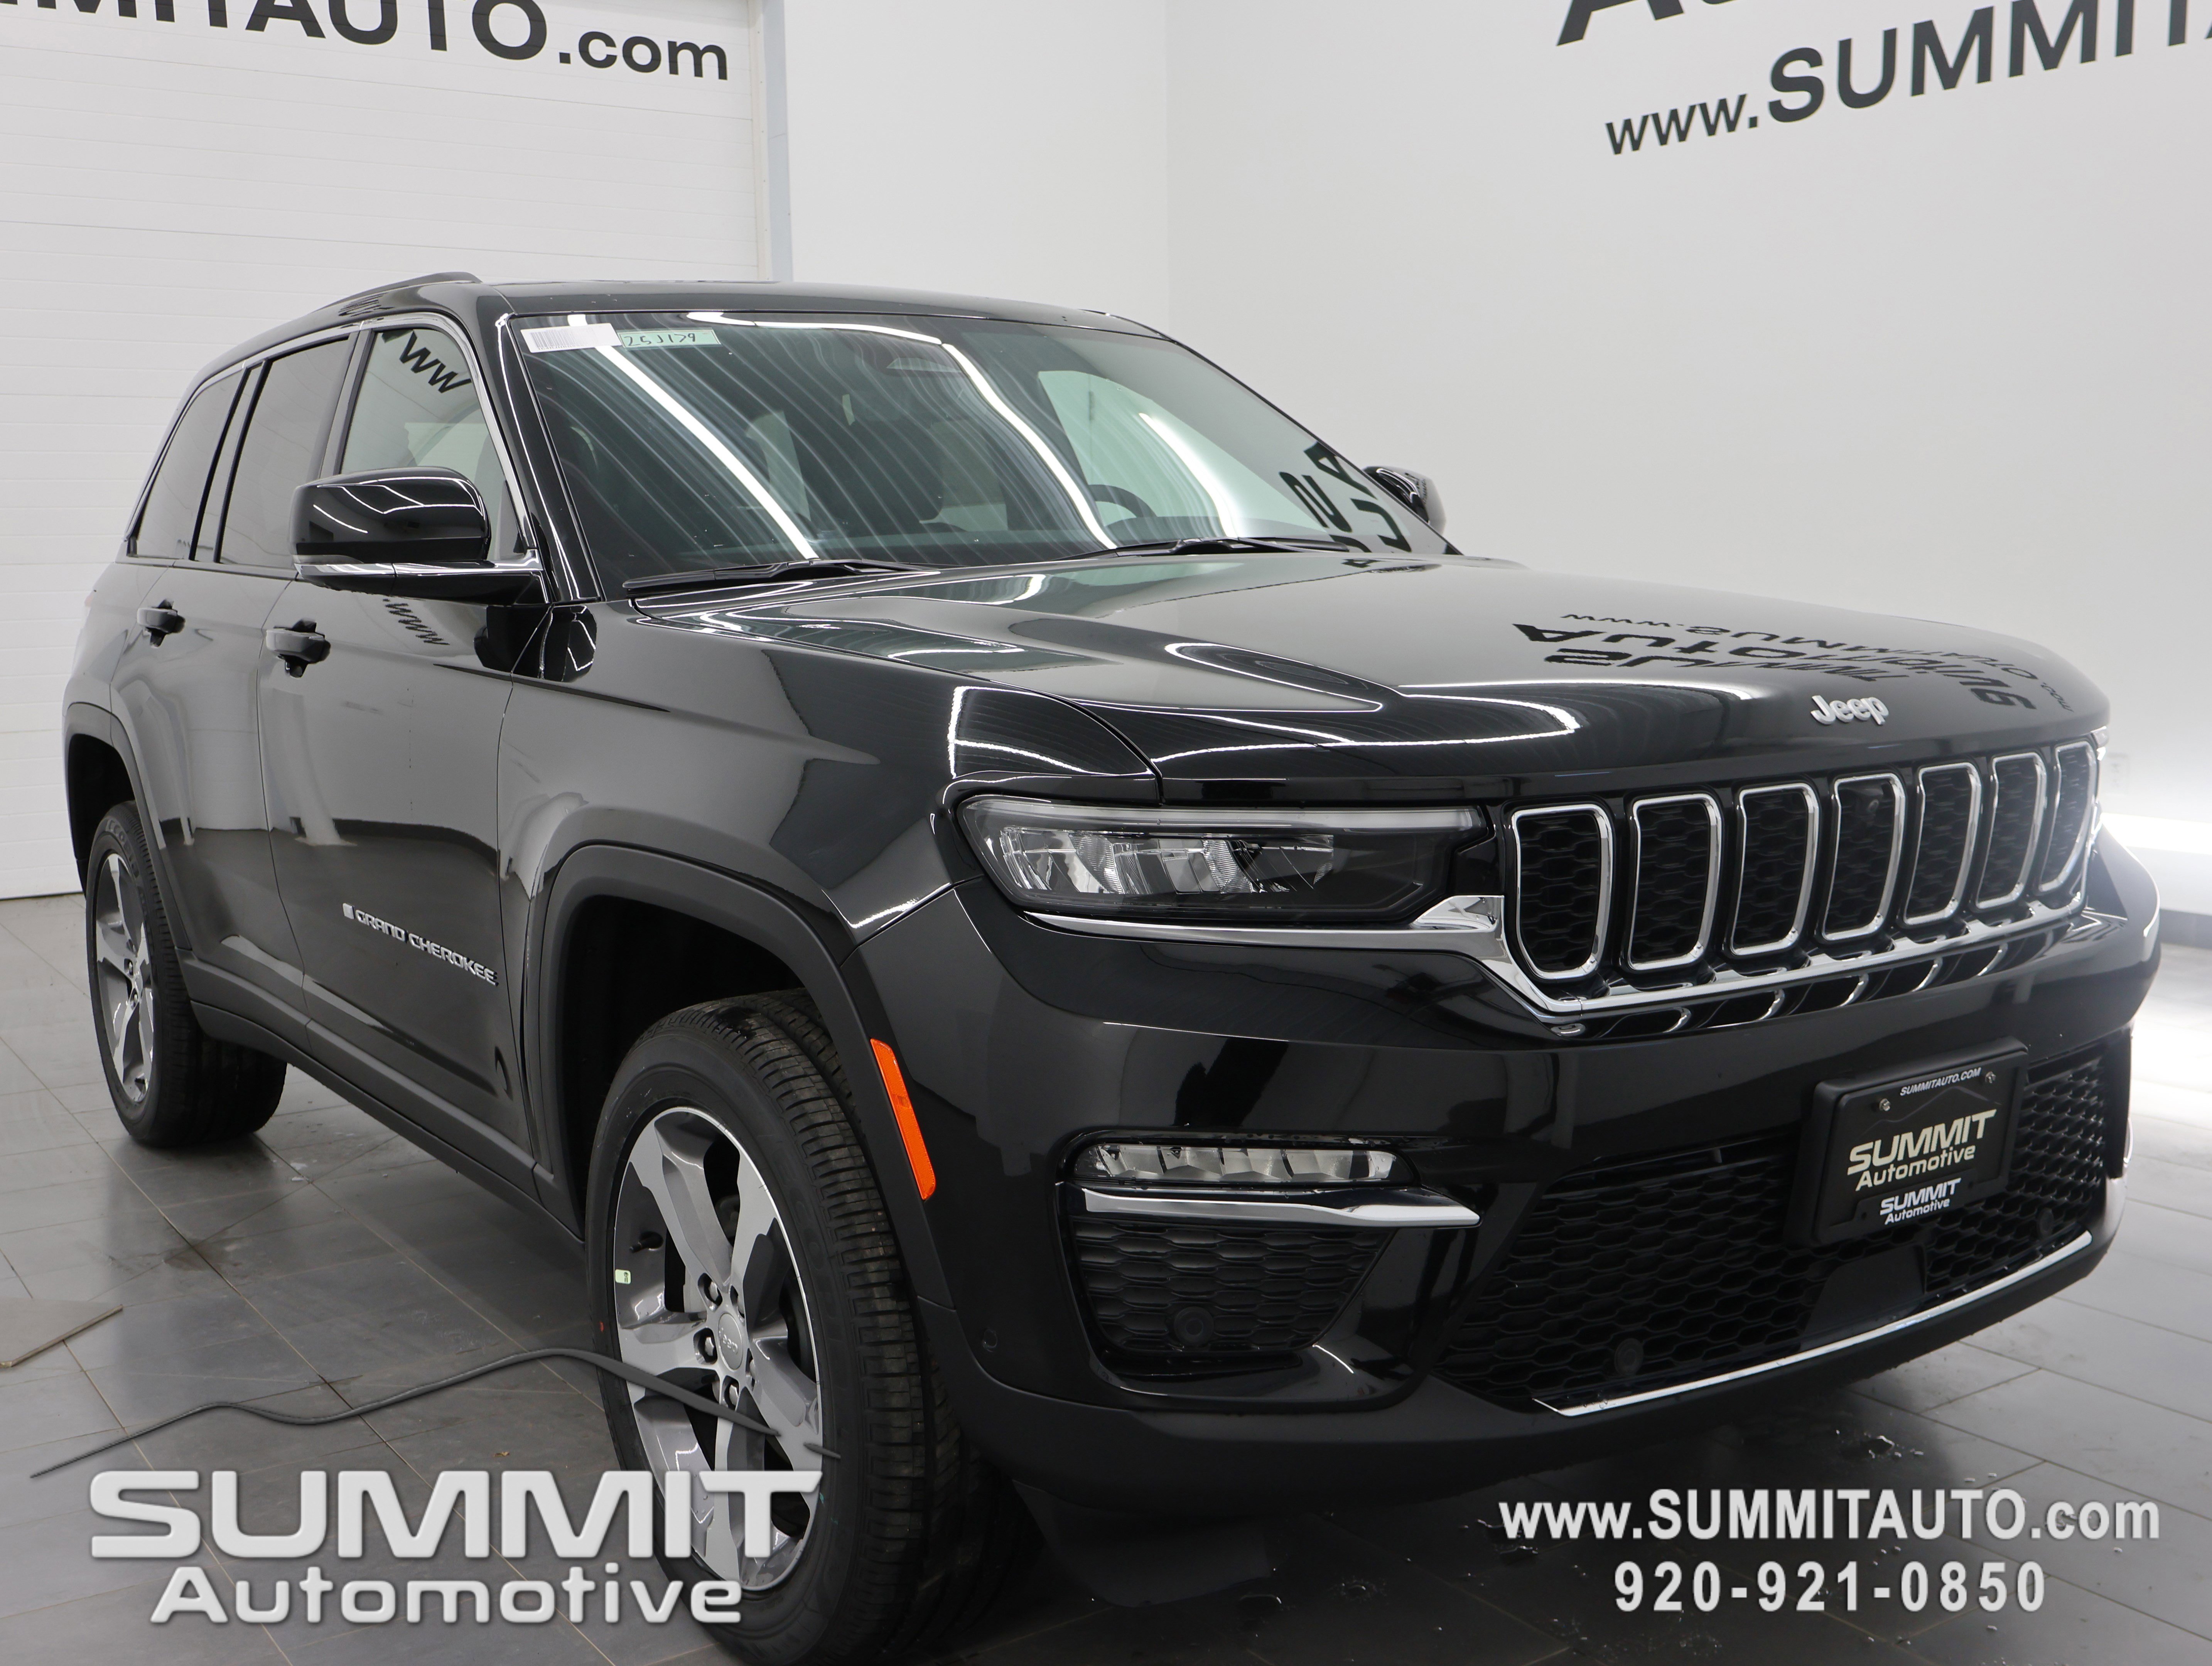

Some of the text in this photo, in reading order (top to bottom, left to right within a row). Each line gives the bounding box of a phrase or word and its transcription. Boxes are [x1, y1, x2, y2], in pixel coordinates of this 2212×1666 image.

[1810, 695, 1889, 725] Jeep
[355, 909, 499, 987] GRAND CHEROKEE
[1899, 1067, 1982, 1096] SUMMITAUTO.COM
[1847, 1108, 1998, 1175] SUMMIT
[1855, 1144, 1976, 1192] Automotive
[1879, 1177, 1962, 1216] SUMMIT
[1884, 1198, 1950, 1225] Automotive
